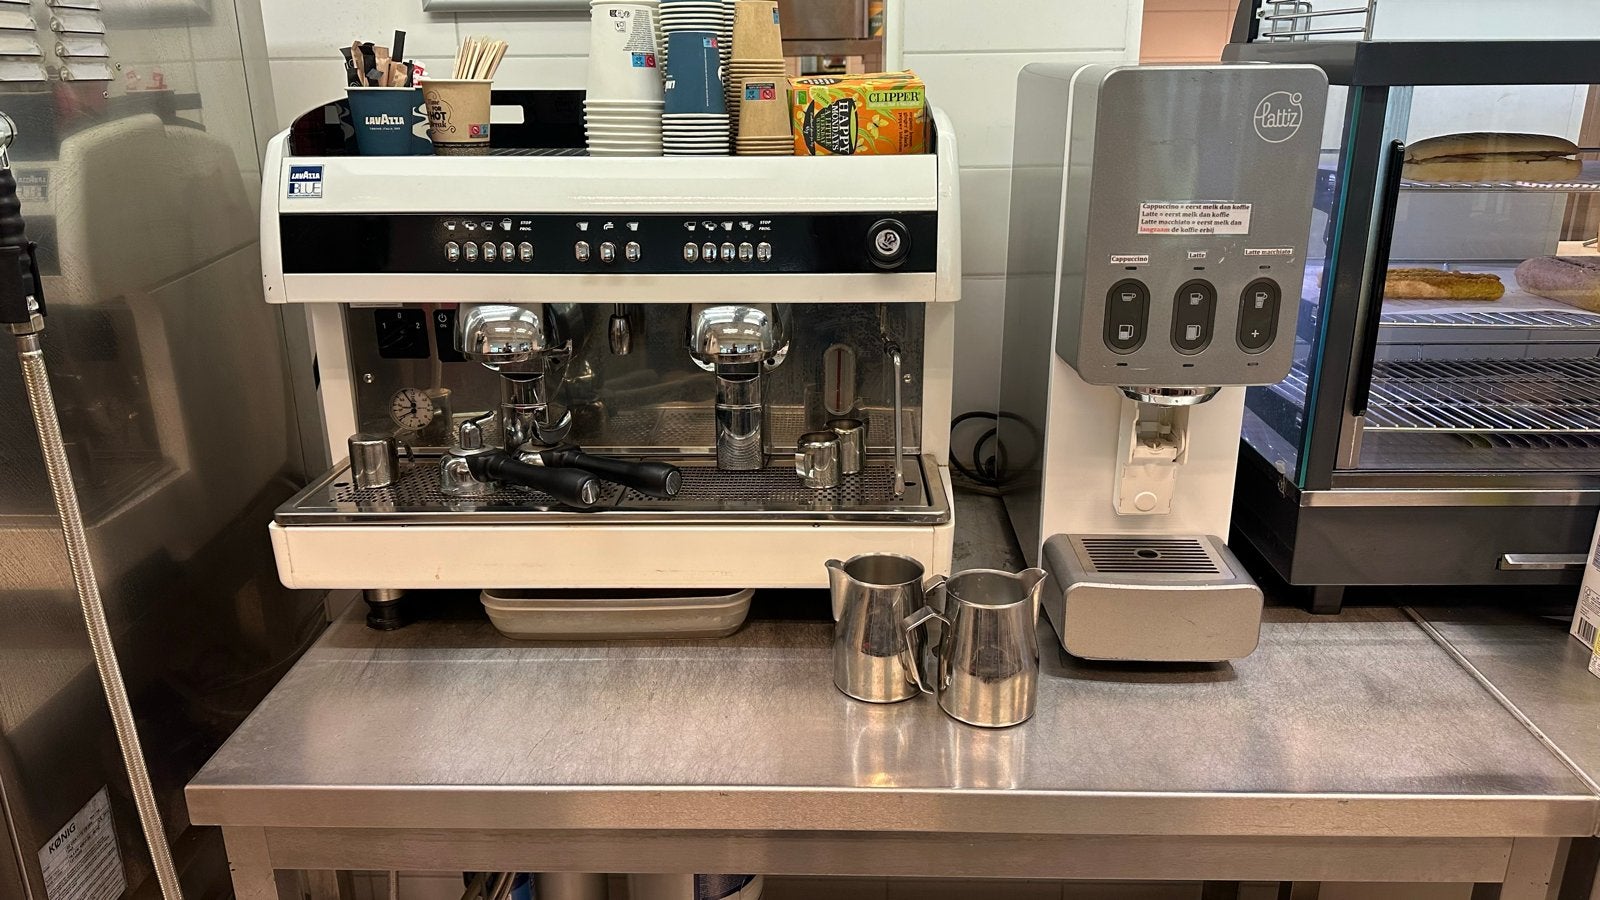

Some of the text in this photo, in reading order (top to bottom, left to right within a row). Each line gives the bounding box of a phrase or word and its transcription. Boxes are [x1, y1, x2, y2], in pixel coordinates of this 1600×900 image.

[868, 91, 920, 103] CLIPPER
[365, 113, 405, 125] LAVAZZA
[839, 101, 850, 154] HAPPY
[291, 170, 321, 180] LAVAZZA
